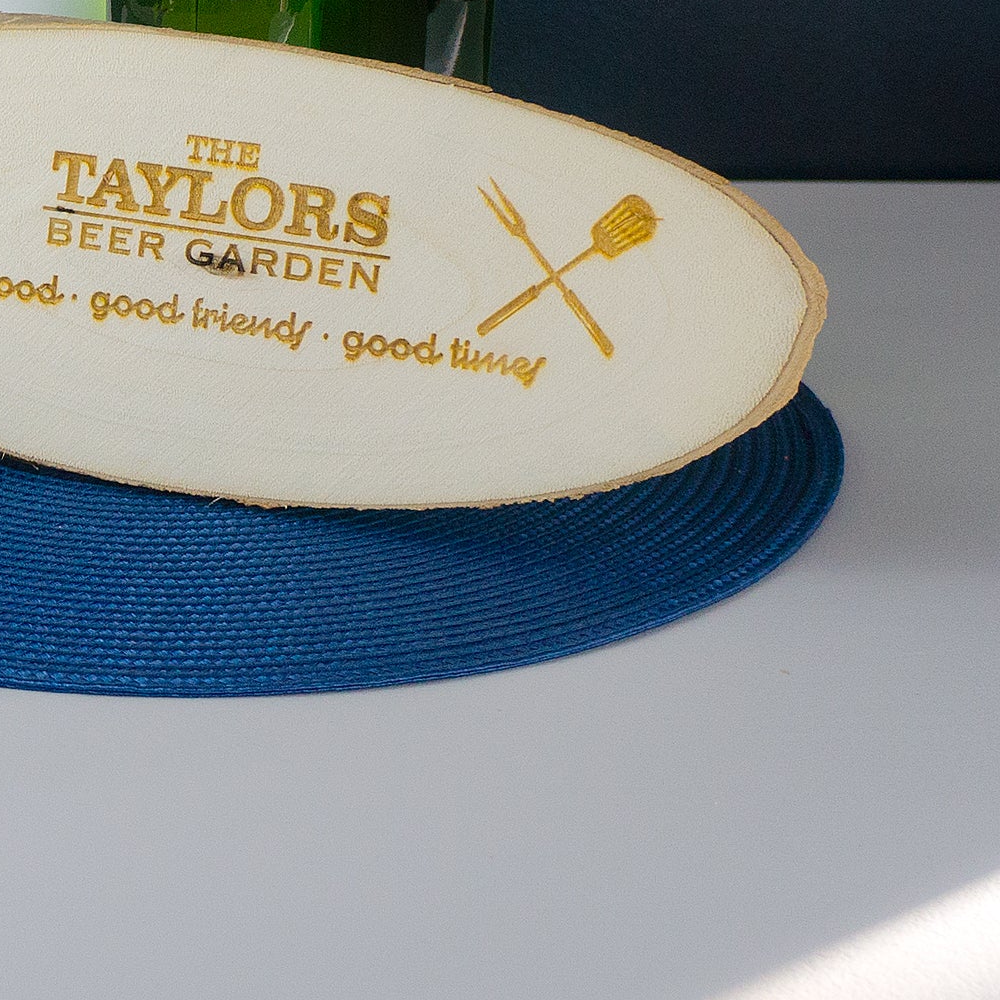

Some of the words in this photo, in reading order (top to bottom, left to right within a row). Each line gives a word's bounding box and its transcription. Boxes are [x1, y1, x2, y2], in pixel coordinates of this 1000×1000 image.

[186, 135, 261, 170] THE
[52, 151, 391, 247] TAYLORS
[47, 218, 165, 261] BEER
[185, 238, 381, 293] GARDEN
[89, 291, 184, 325] good
[192, 298, 312, 350] friends
[342, 331, 443, 366] good
[448, 338, 547, 388] times
